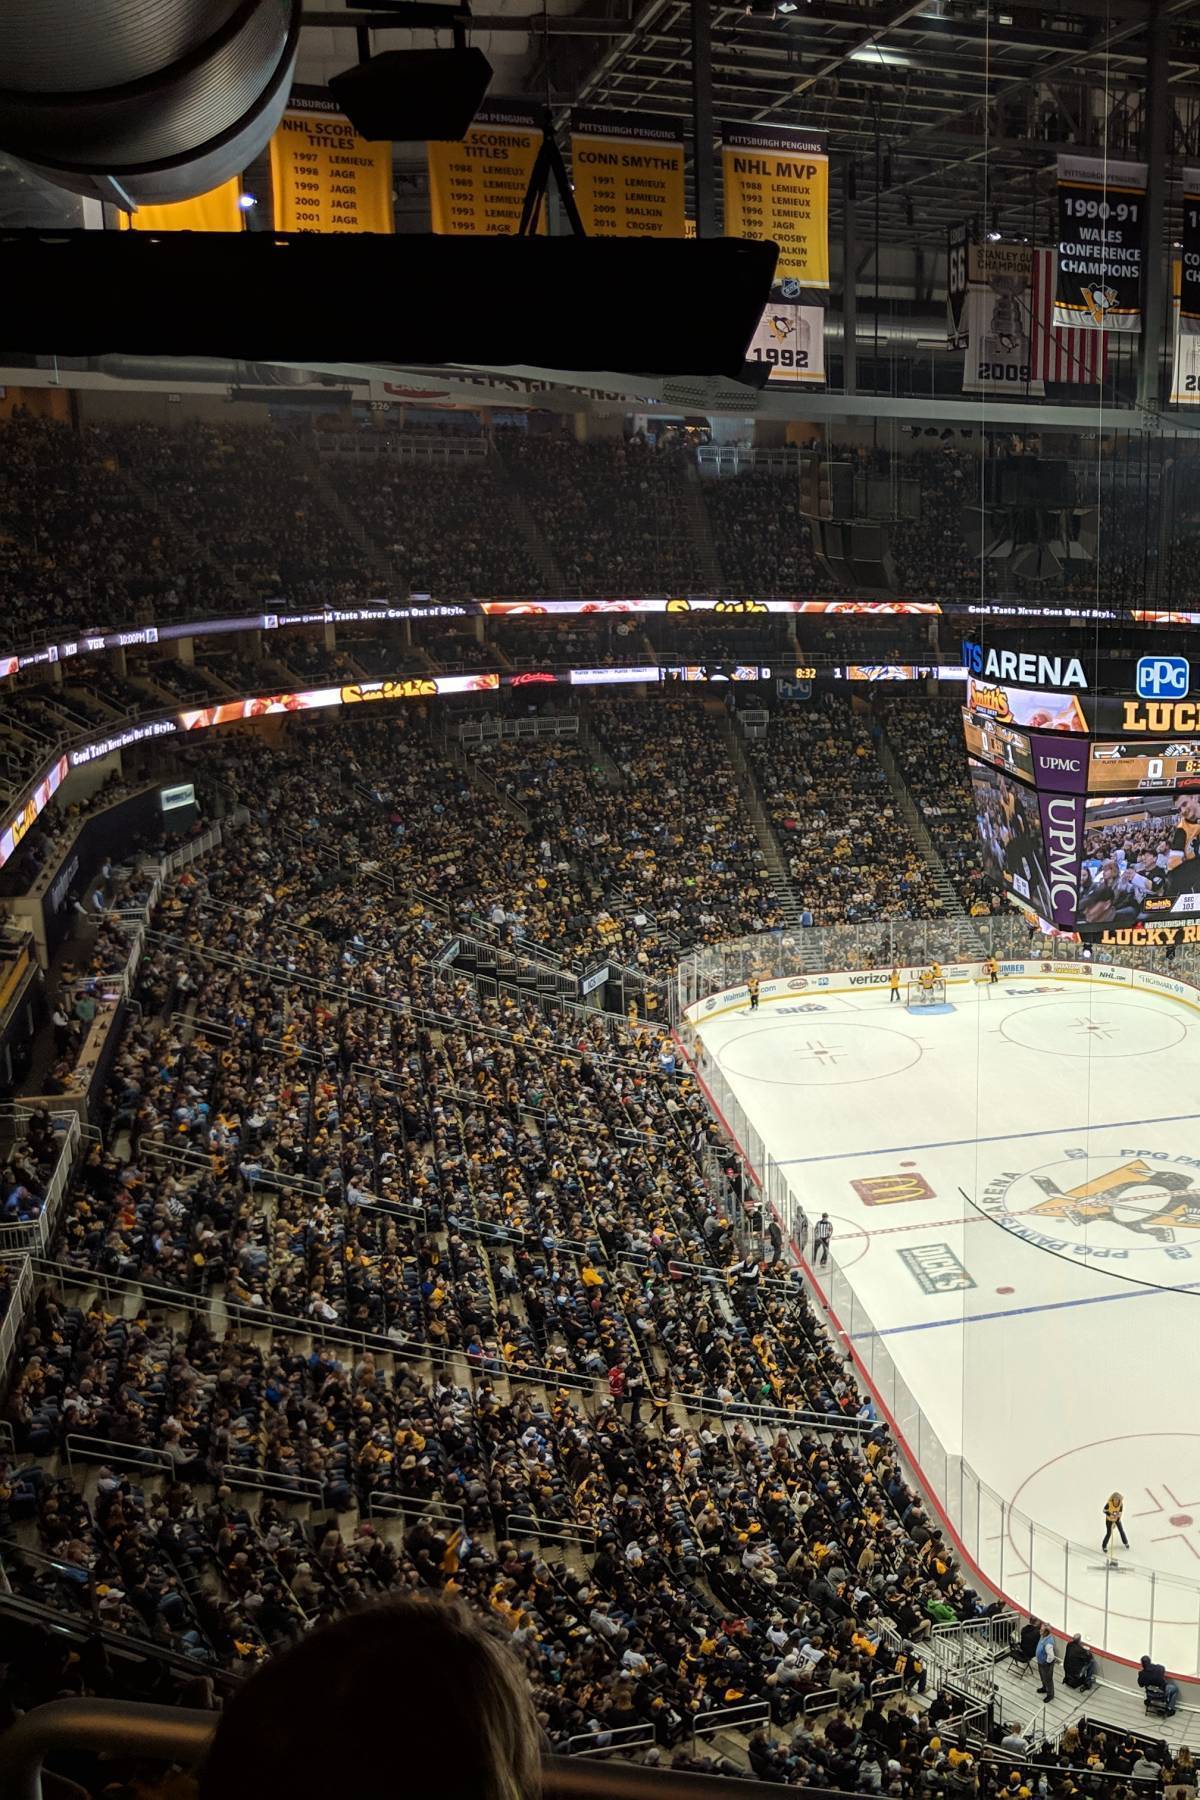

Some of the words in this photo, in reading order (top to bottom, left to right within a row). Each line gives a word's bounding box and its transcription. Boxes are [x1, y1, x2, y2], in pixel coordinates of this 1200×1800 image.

[579, 122, 633, 135] PITTSBURGH
[633, 129, 677, 139] PENGUINS
[307, 135, 354, 149] TITLES
[471, 133, 531, 148] SCORING
[730, 136, 779, 148] PITTSBURGH
[781, 141, 821, 152] PENGUINS
[293, 152, 318, 162] 1997
[329, 155, 374, 167] LEMIEUX
[463, 146, 509, 159] TITLES
[578, 152, 618, 165] CONN
[621, 155, 679, 171] SMYTHE
[329, 170, 356, 179] JAGR
[482, 166, 525, 176] LEMIEUX
[733, 158, 771, 176] NHL
[776, 162, 817, 180] MVP
[295, 181, 319, 191] 1999
[330, 184, 356, 194] JAGR
[483, 180, 527, 191] LEMIEUX
[625, 178, 666, 189] LEMIEUX
[771, 184, 810, 194] LEMIEUX
[295, 196, 320, 207] 2000
[331, 200, 357, 210] JAGR
[625, 193, 666, 203] LEMIEUX
[772, 196, 811, 207] LEMIEUX
[625, 206, 663, 217] MALKIN
[772, 209, 811, 219] LEMIEUX
[1065, 198, 1138, 222] 1990-91
[296, 212, 320, 222] 2001
[331, 216, 358, 225] JAGR
[773, 221, 795, 230] JAGR
[626, 221, 663, 231] CROSBY
[772, 232, 807, 243] CROSBY
[1079, 227, 1123, 243] WALES
[1059, 243, 1141, 261] CONFERENCE
[1061, 259, 1139, 278] CHAMPIONS
[753, 347, 808, 368] 1992
[978, 364, 1032, 382] 2009
[334, 611, 357, 621] Taste
[360, 610, 385, 620] Never
[389, 609, 409, 619] Goes
[412, 608, 427, 617] Out
[968, 606, 991, 615] Good
[1044, 608, 1063, 617] Goes
[1065, 609, 1080, 618] Out
[88, 637, 105, 651] VGK
[120, 633, 146, 646] 10:00PM
[796, 667, 816, 679] 8:32
[985, 648, 1088, 688] ARENA
[1040, 756, 1080, 772] UPMC
[1148, 759, 1163, 778] 0
[1048, 798, 1078, 912] UPMC
[1101, 928, 1180, 946] LUCKY
[1120, 1148, 1169, 1160] PPG
[982, 1171, 1022, 1214] ARENA
